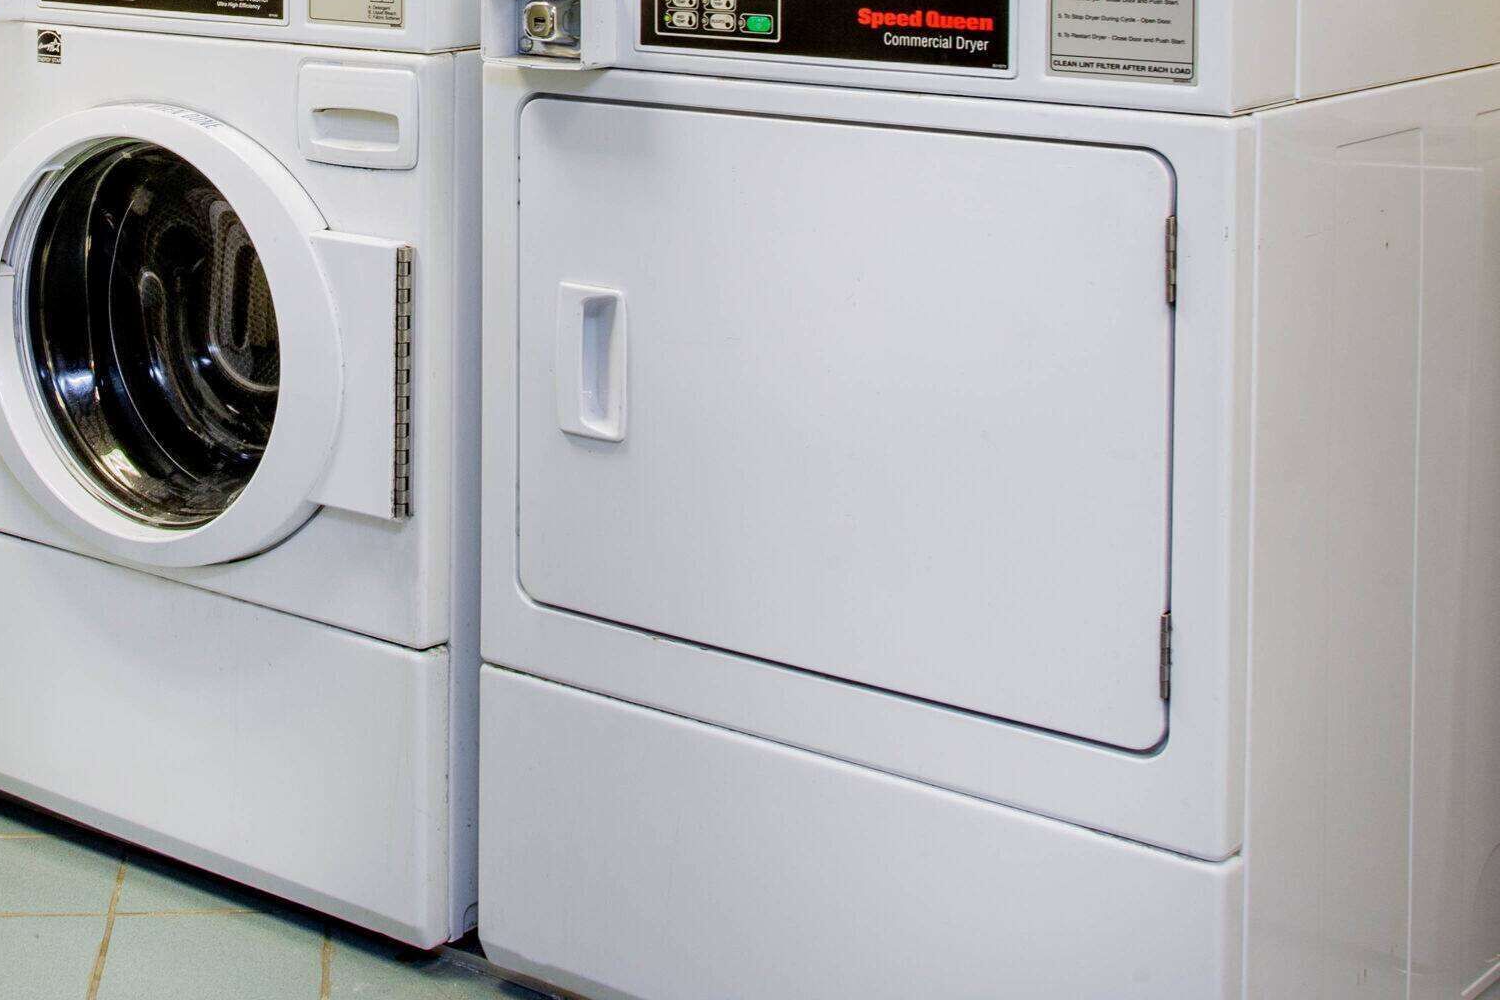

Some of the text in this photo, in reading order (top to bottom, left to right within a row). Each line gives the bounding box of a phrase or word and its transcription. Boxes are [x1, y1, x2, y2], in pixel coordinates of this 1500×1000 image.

[239, 2, 261, 10] Efficiency
[857, 7, 994, 31] Speed Queen
[883, 32, 990, 53] Commercial Dryer
[1096, 62, 1120, 70] FILTER
[1122, 64, 1146, 72] AFTER
[1148, 65, 1168, 73] EACH
[1170, 67, 1191, 75] LOAD
